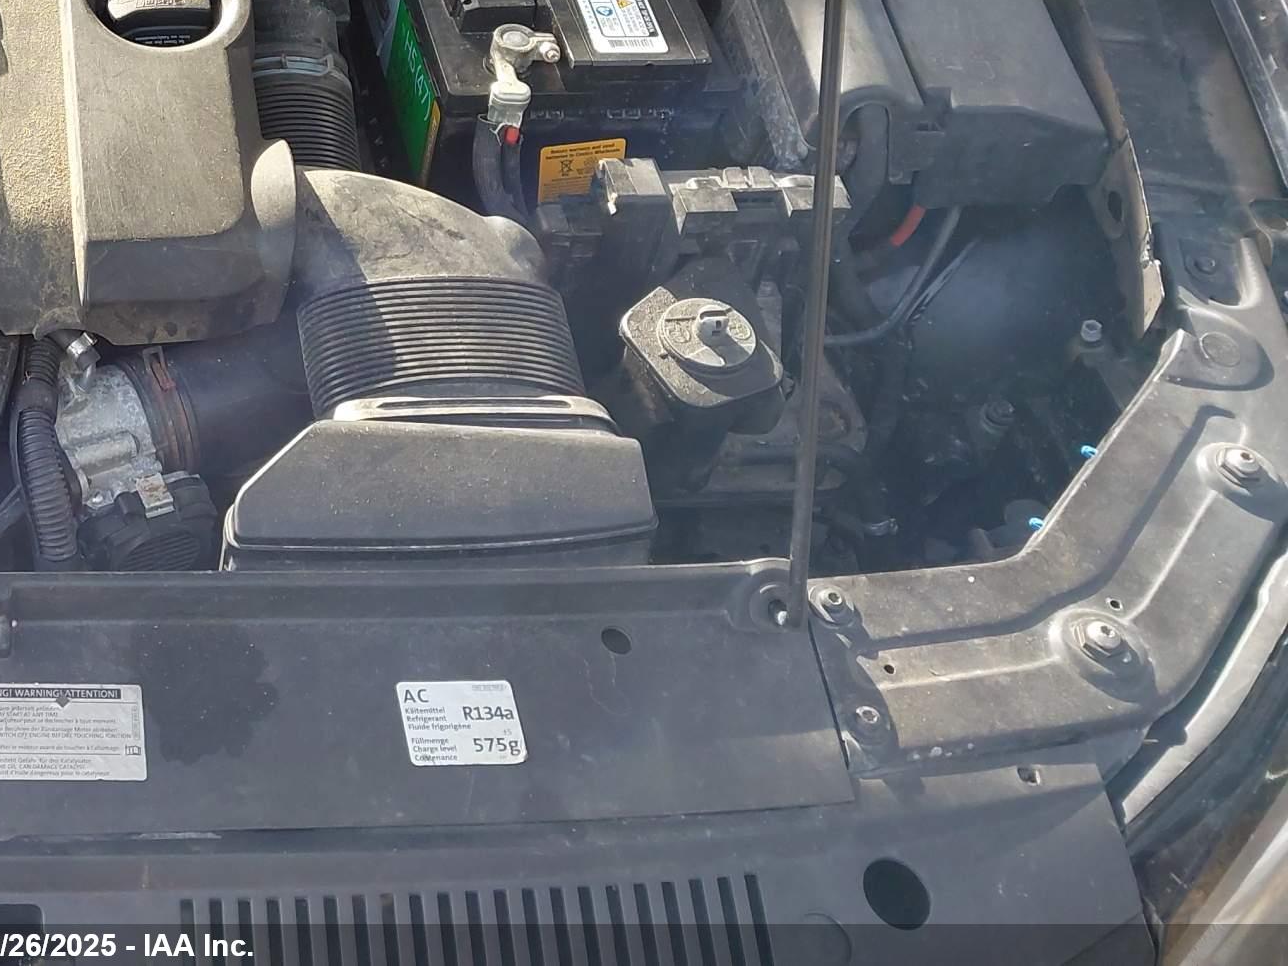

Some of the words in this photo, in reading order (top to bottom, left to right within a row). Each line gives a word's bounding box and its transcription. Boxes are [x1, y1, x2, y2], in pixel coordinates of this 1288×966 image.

[403, 30, 417, 70] H5
[14, 688, 63, 698] WARNING!
[64, 689, 119, 699] ATTENTION!
[404, 689, 429, 703] AC
[406, 716, 448, 724] Refrigerant
[462, 706, 515, 721] R134a
[473, 737, 521, 756] 575g
